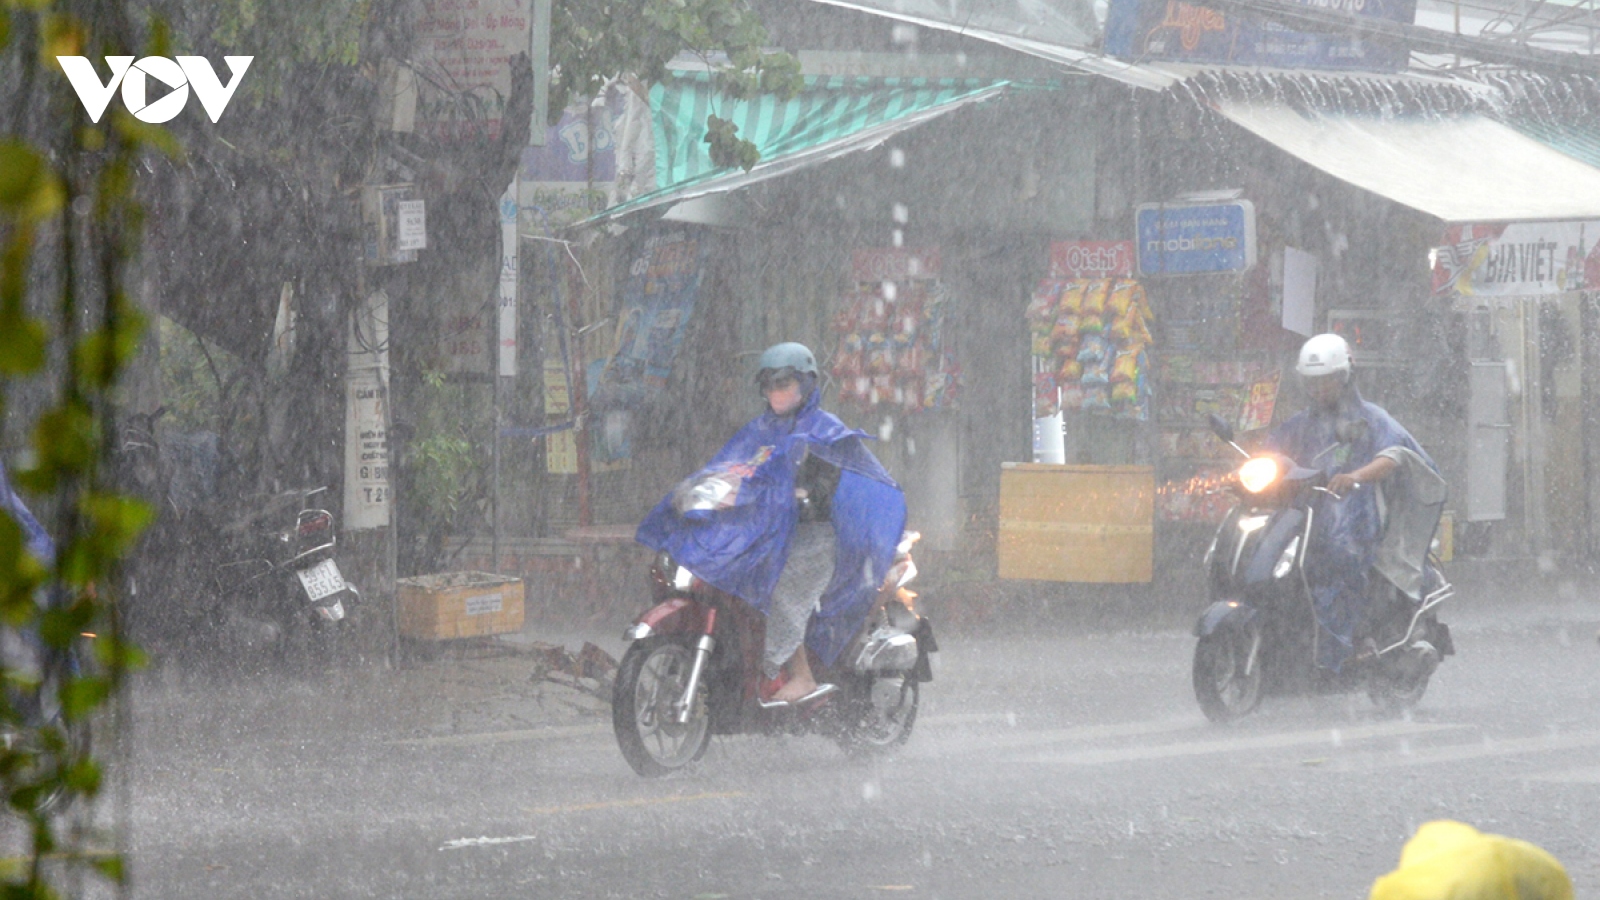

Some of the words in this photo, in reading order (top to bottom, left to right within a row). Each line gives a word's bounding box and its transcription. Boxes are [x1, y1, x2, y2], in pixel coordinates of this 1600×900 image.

[1067, 246, 1118, 273] Oishi
[1484, 243, 1516, 283] BIA
[360, 466, 369, 479] G
